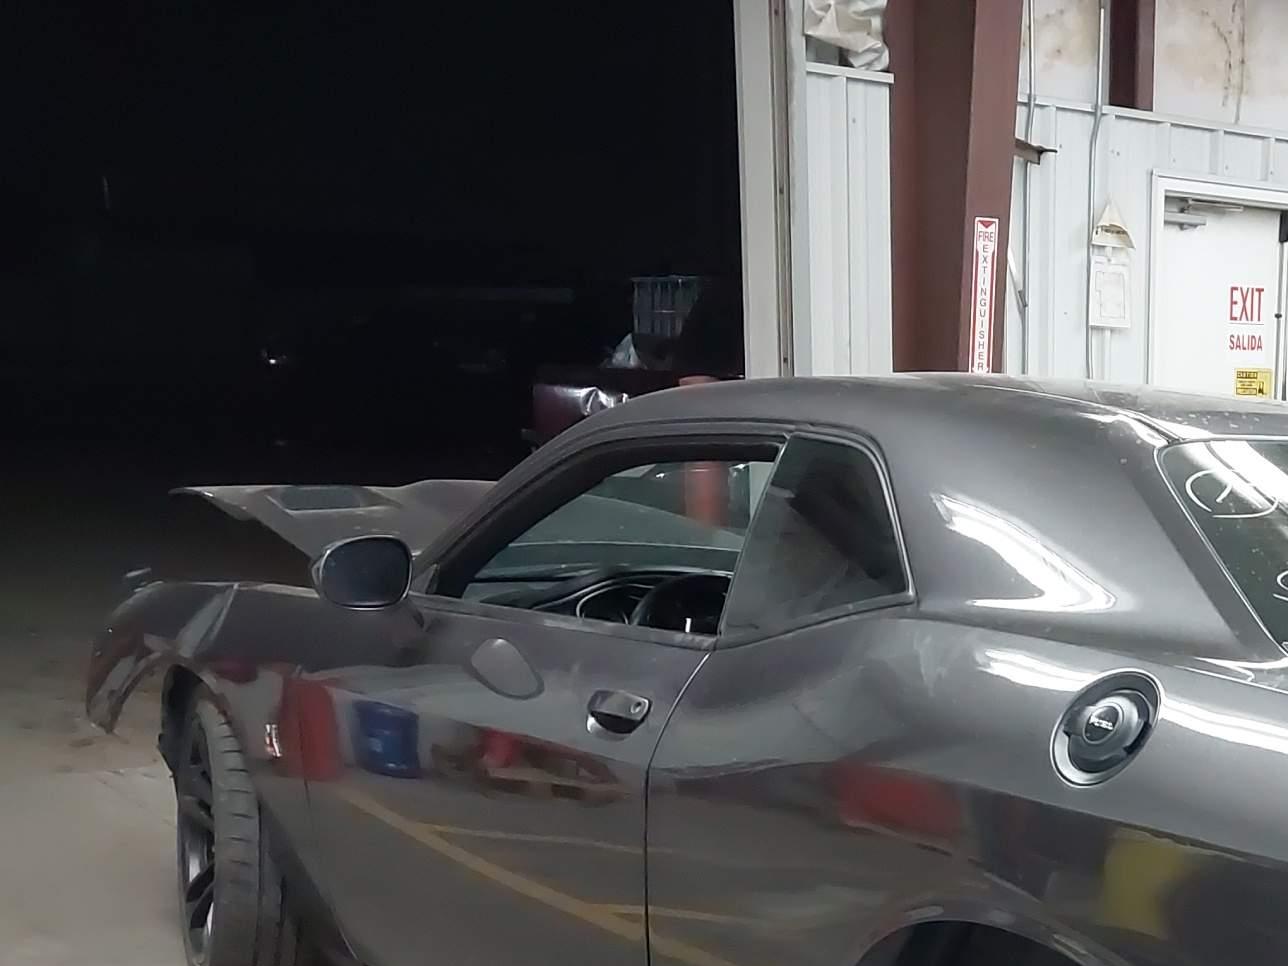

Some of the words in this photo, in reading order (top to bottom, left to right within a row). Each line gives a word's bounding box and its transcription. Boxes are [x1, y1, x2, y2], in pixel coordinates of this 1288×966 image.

[977, 230, 994, 243] FIRE
[977, 244, 989, 372] EXTINGUISHER
[1229, 285, 1265, 322] EXIT
[1228, 333, 1264, 352] SALIDA
